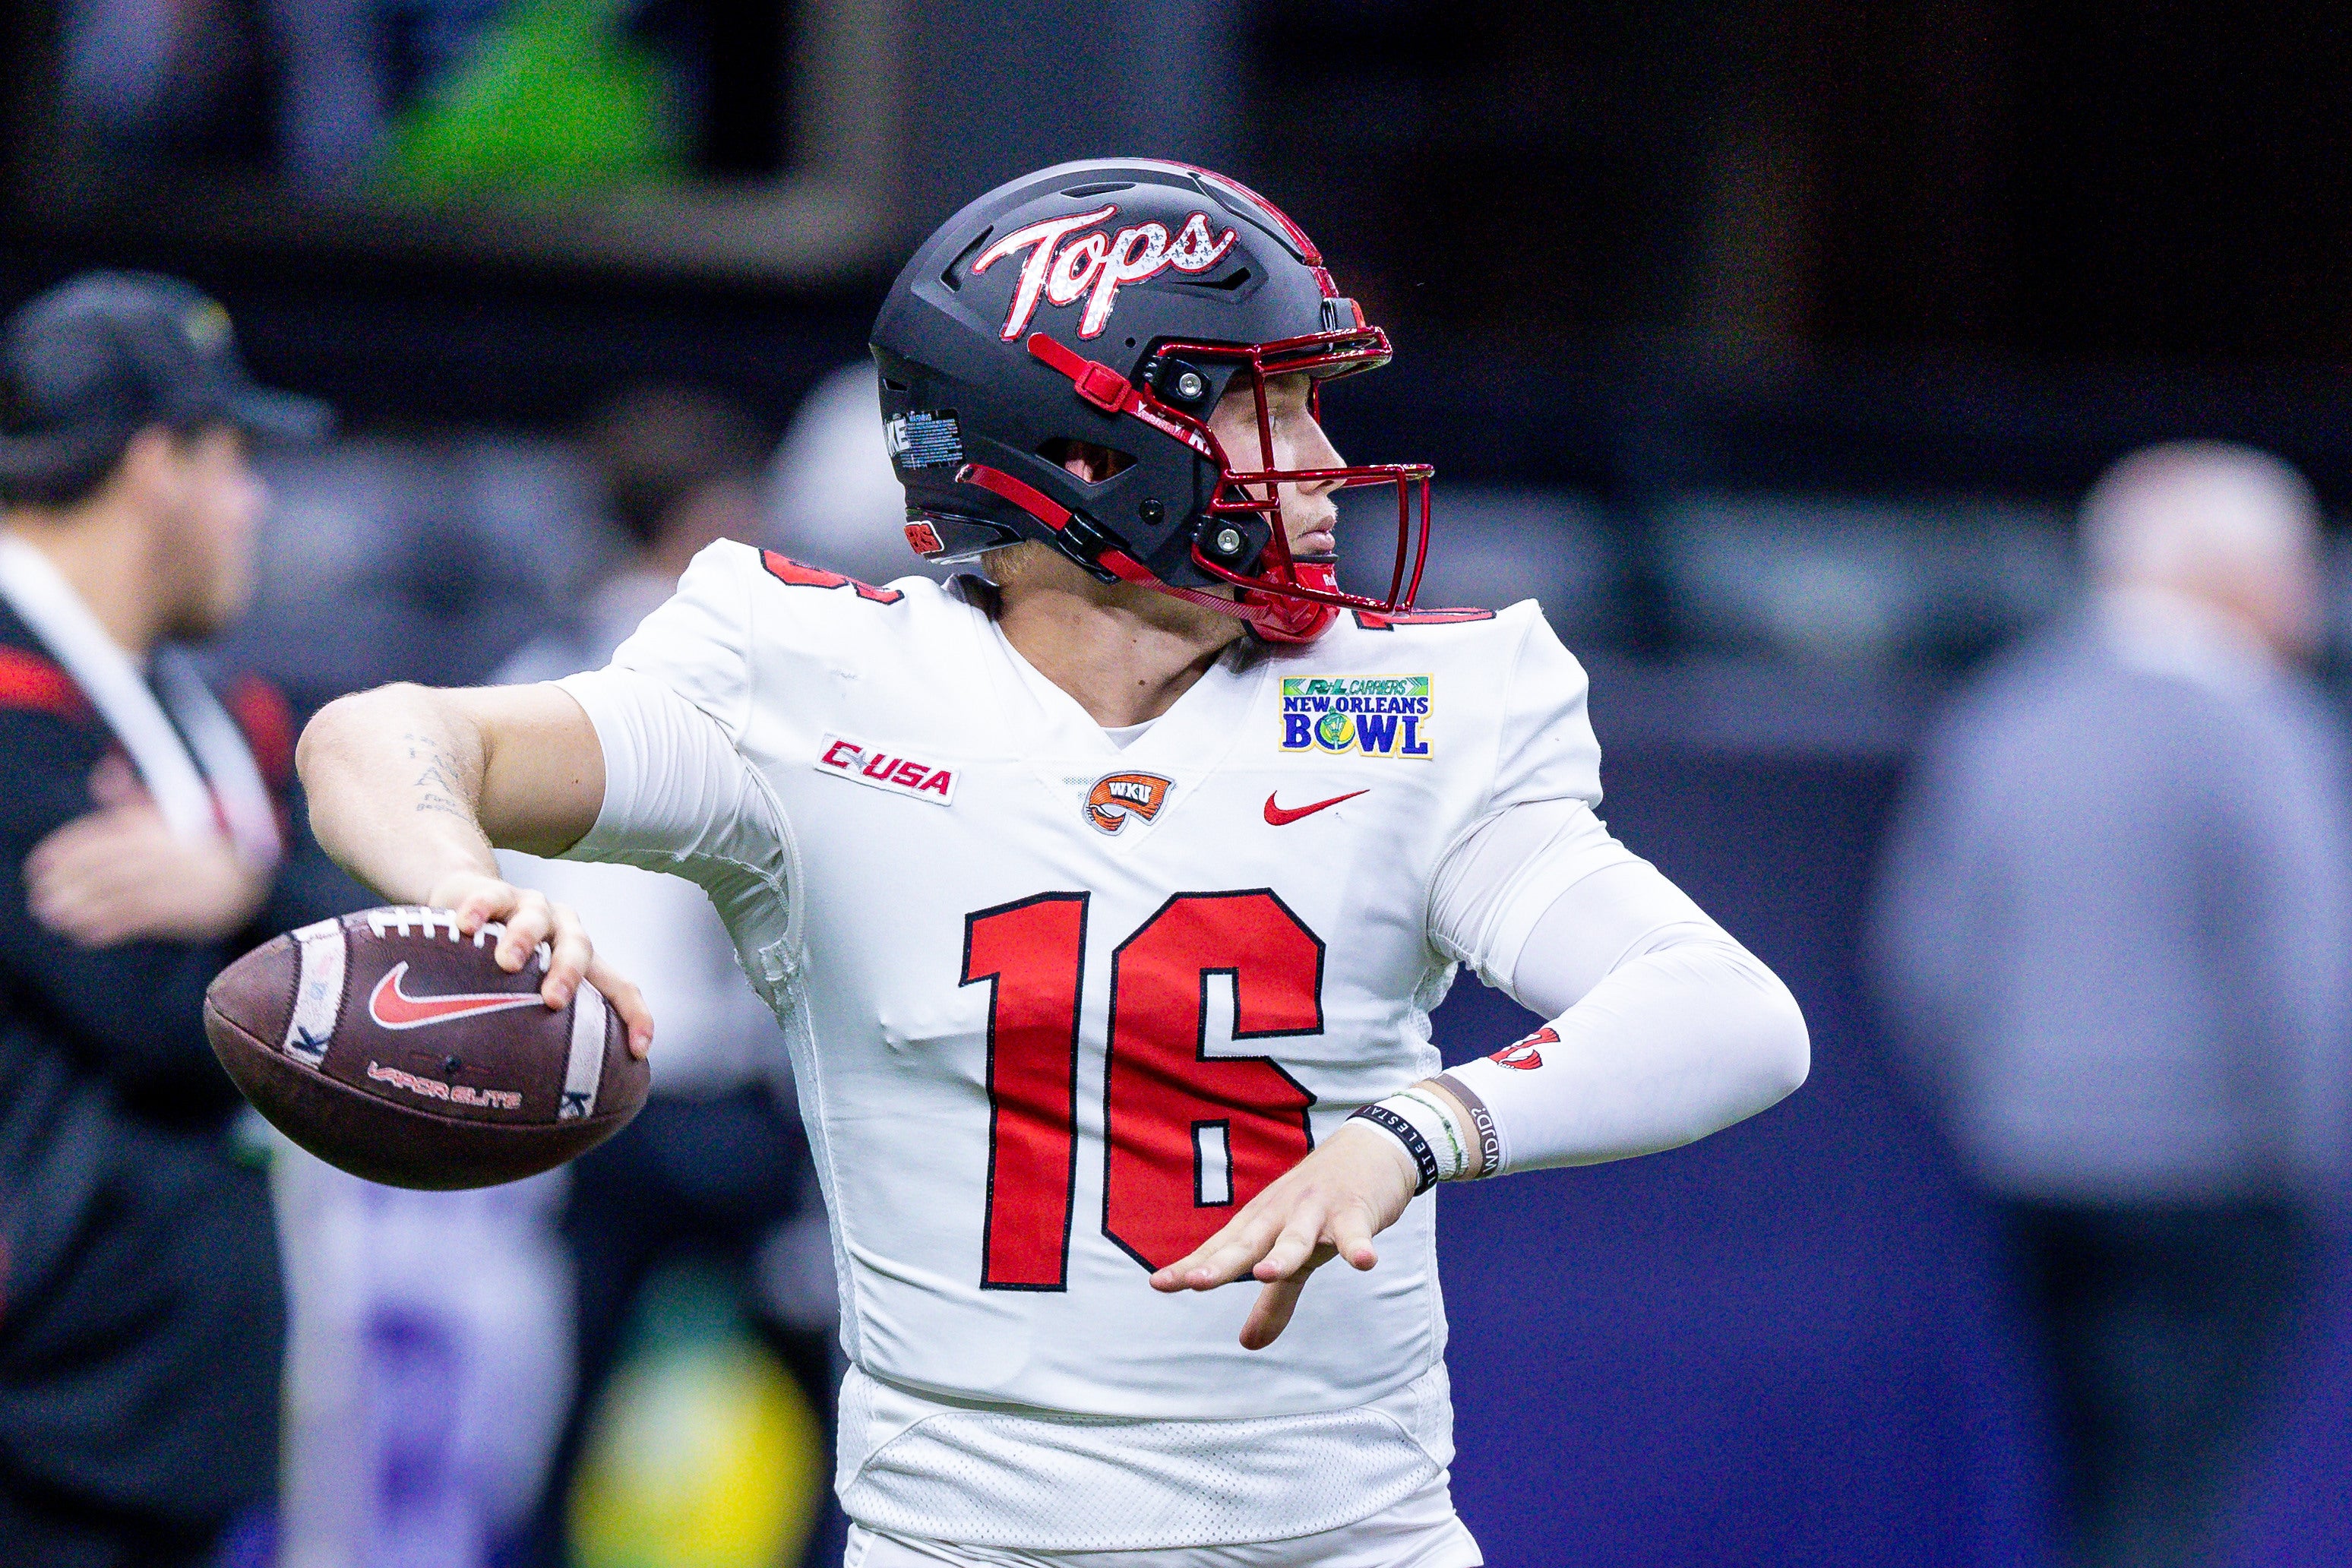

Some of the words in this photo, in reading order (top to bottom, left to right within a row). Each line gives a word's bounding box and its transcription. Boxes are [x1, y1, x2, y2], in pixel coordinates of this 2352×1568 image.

[972, 204, 1239, 342] Tops
[1284, 697, 1331, 713] NEW
[1335, 697, 1429, 715] ORLEANS
[1350, 679, 1406, 696] CARRIERS
[1282, 713, 1428, 754] BOWL
[1108, 782, 1152, 804] WKU
[959, 887, 1326, 1293] 16
[1471, 1107, 1500, 1174] WDJD?
